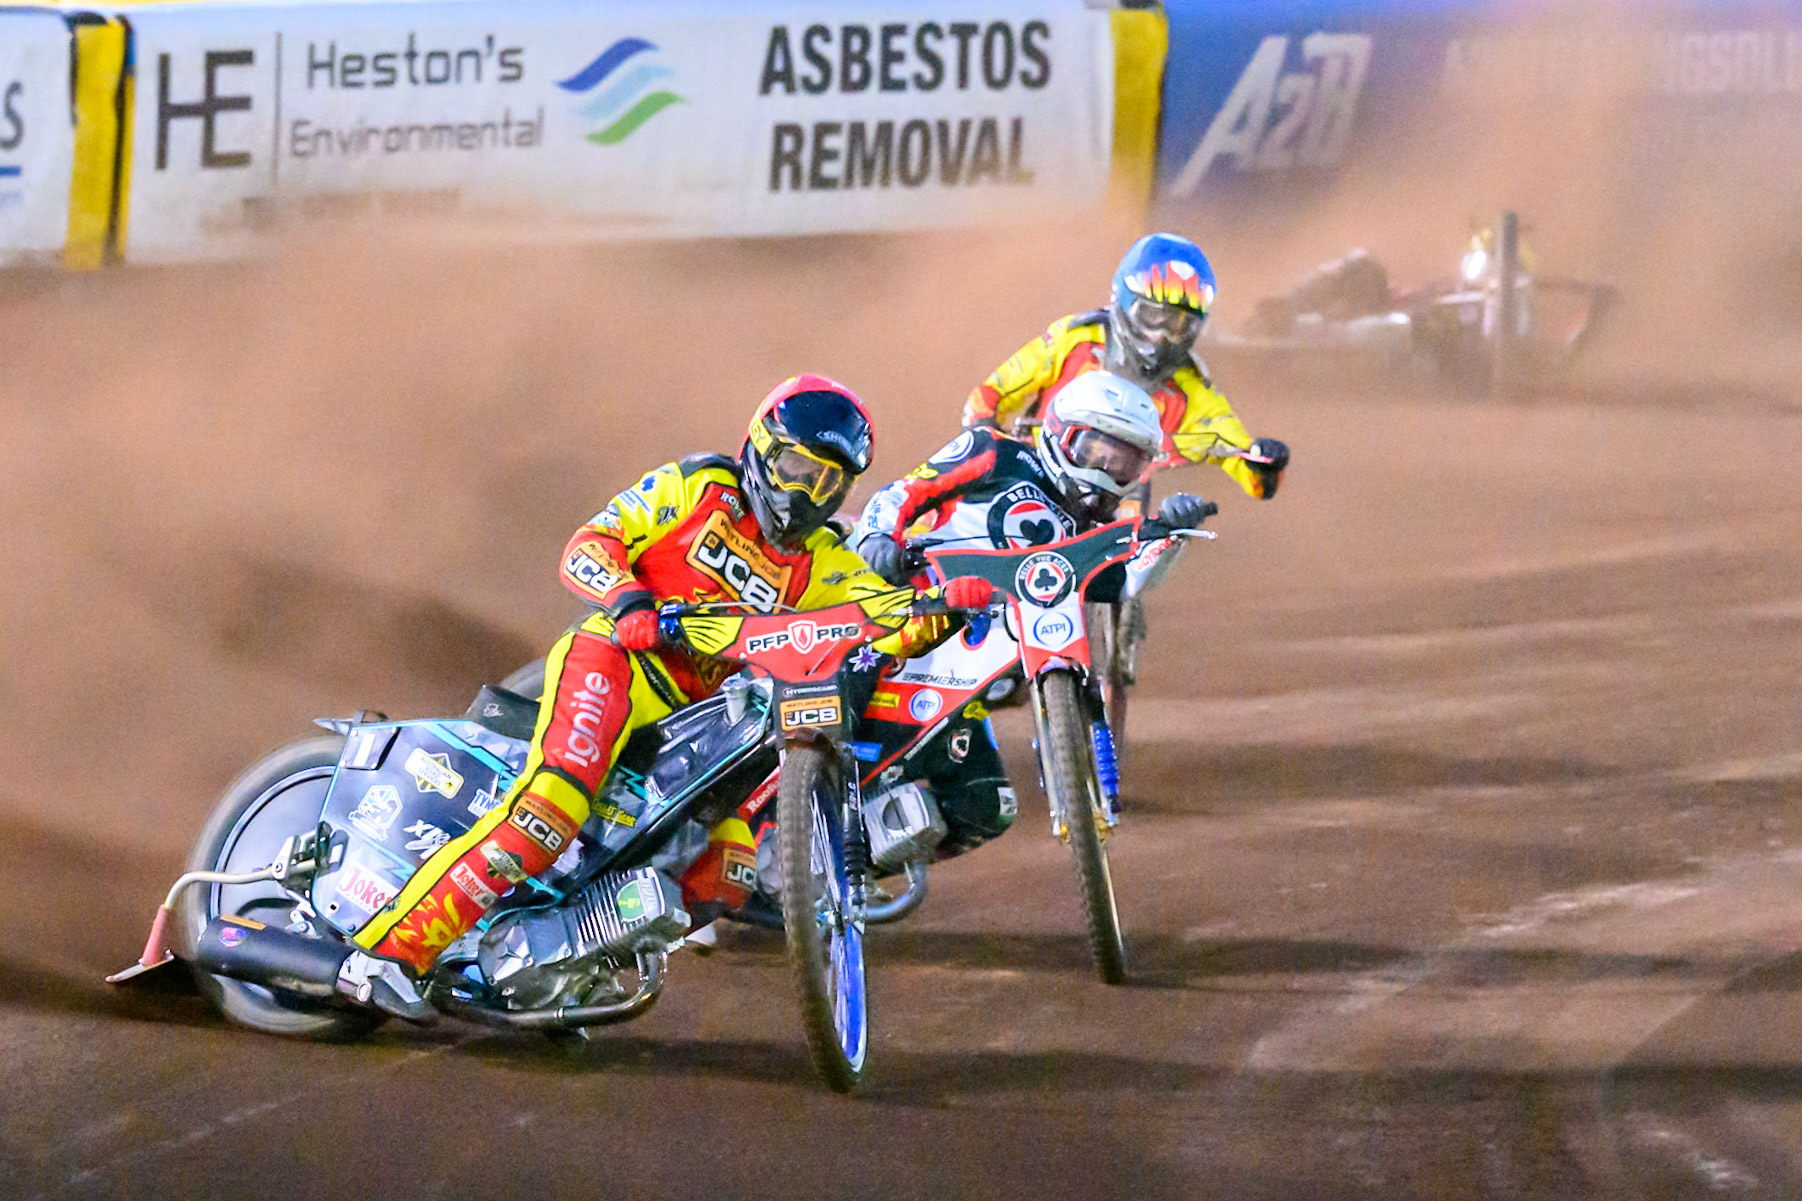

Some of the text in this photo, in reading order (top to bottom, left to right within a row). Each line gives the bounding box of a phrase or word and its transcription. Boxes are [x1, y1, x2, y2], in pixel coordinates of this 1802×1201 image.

[307, 34, 525, 90] Heston's
[760, 20, 1051, 95] ASBESTOS
[290, 108, 545, 158] Environmental
[769, 117, 1035, 193] REMOVAL
[566, 553, 618, 593] JCB
[697, 544, 778, 613] JCB
[749, 626, 861, 651] PFP PRO
[1041, 622, 1066, 635] ATPI
[564, 671, 610, 768] Ignite
[786, 707, 837, 726] JCB
[513, 811, 563, 852] JCB
[727, 864, 756, 888] JC
